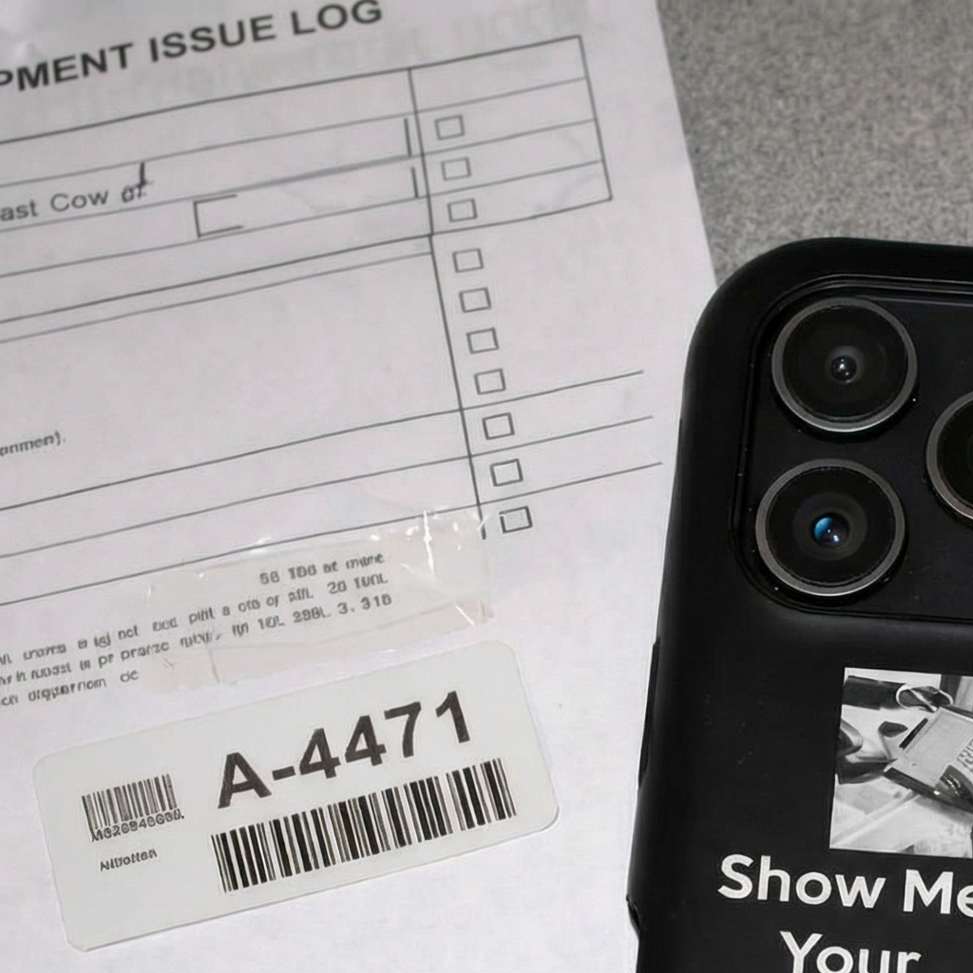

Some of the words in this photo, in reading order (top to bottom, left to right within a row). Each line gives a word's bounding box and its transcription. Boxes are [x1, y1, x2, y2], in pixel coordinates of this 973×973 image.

[150, 15, 276, 62] ISSUE
[291, 0, 382, 35] LOG
[50, 190, 109, 212] Cow
[217, 690, 471, 809] A-4471
[717, 854, 886, 909] Show
